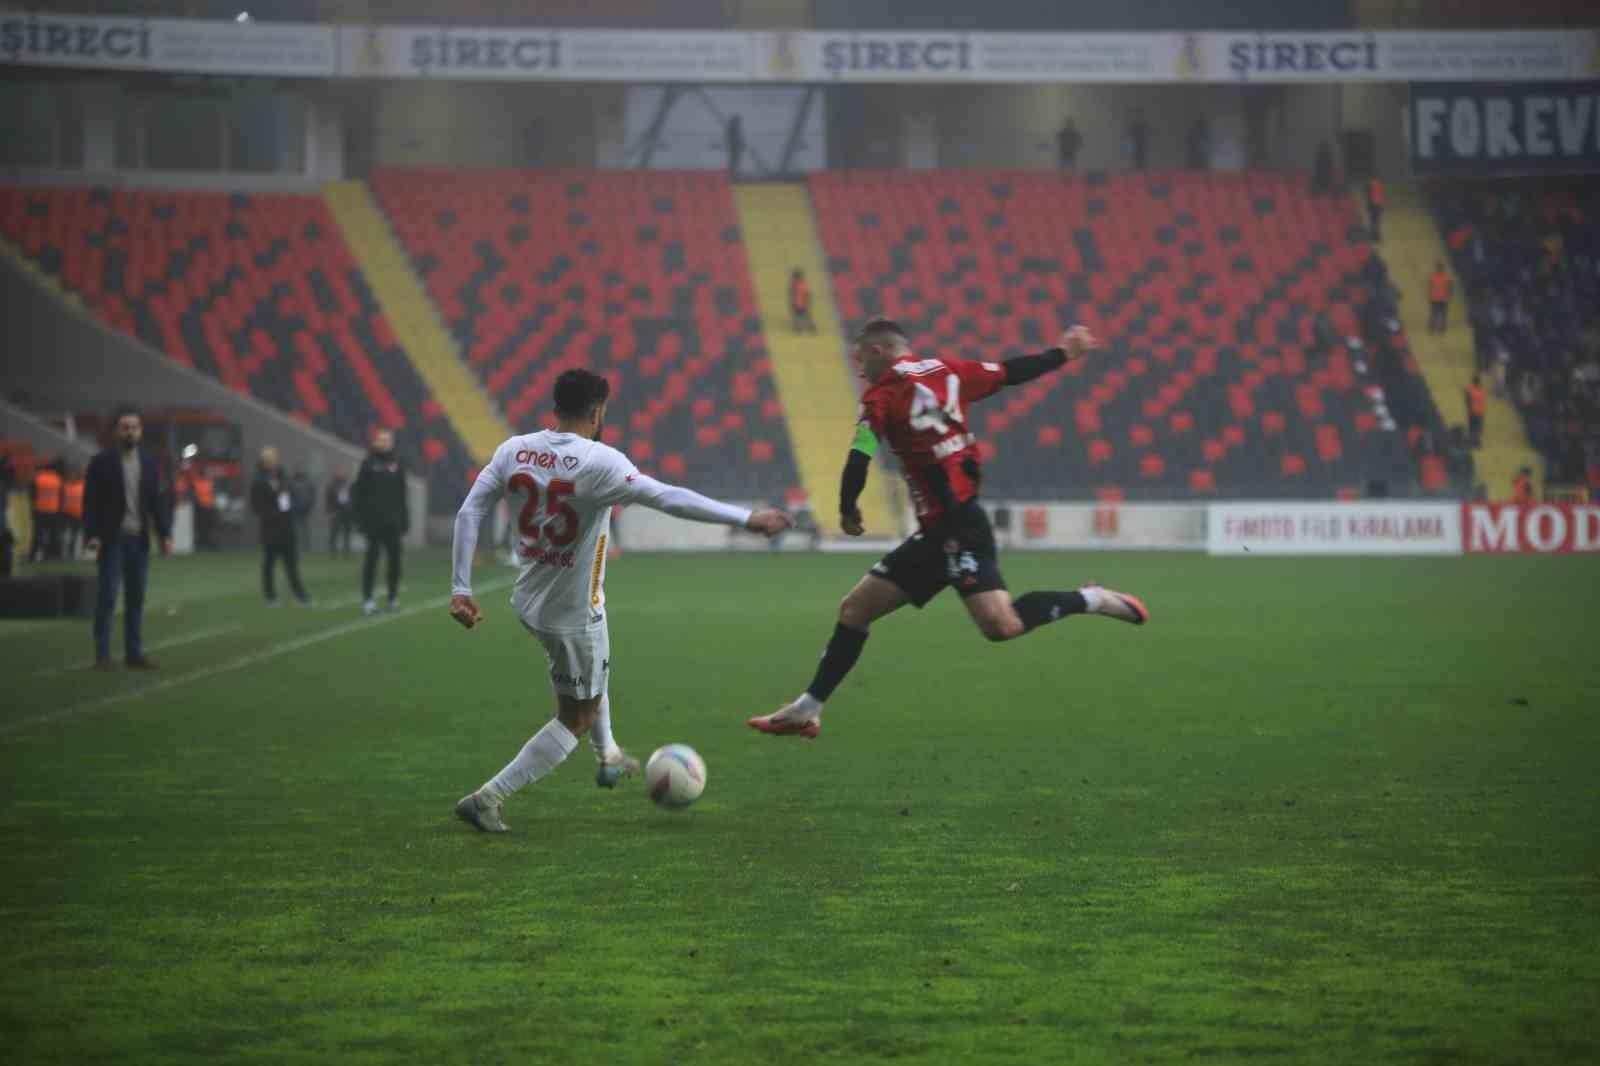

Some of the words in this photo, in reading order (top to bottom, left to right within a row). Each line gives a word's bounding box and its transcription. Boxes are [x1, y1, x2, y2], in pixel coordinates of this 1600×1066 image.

[821, 32, 974, 79] ŞİRECİ
[1228, 33, 1379, 80] ŞİRECİ
[1416, 96, 1600, 157] FOREV
[508, 473, 578, 545] 25
[1472, 507, 1600, 551] MOD
